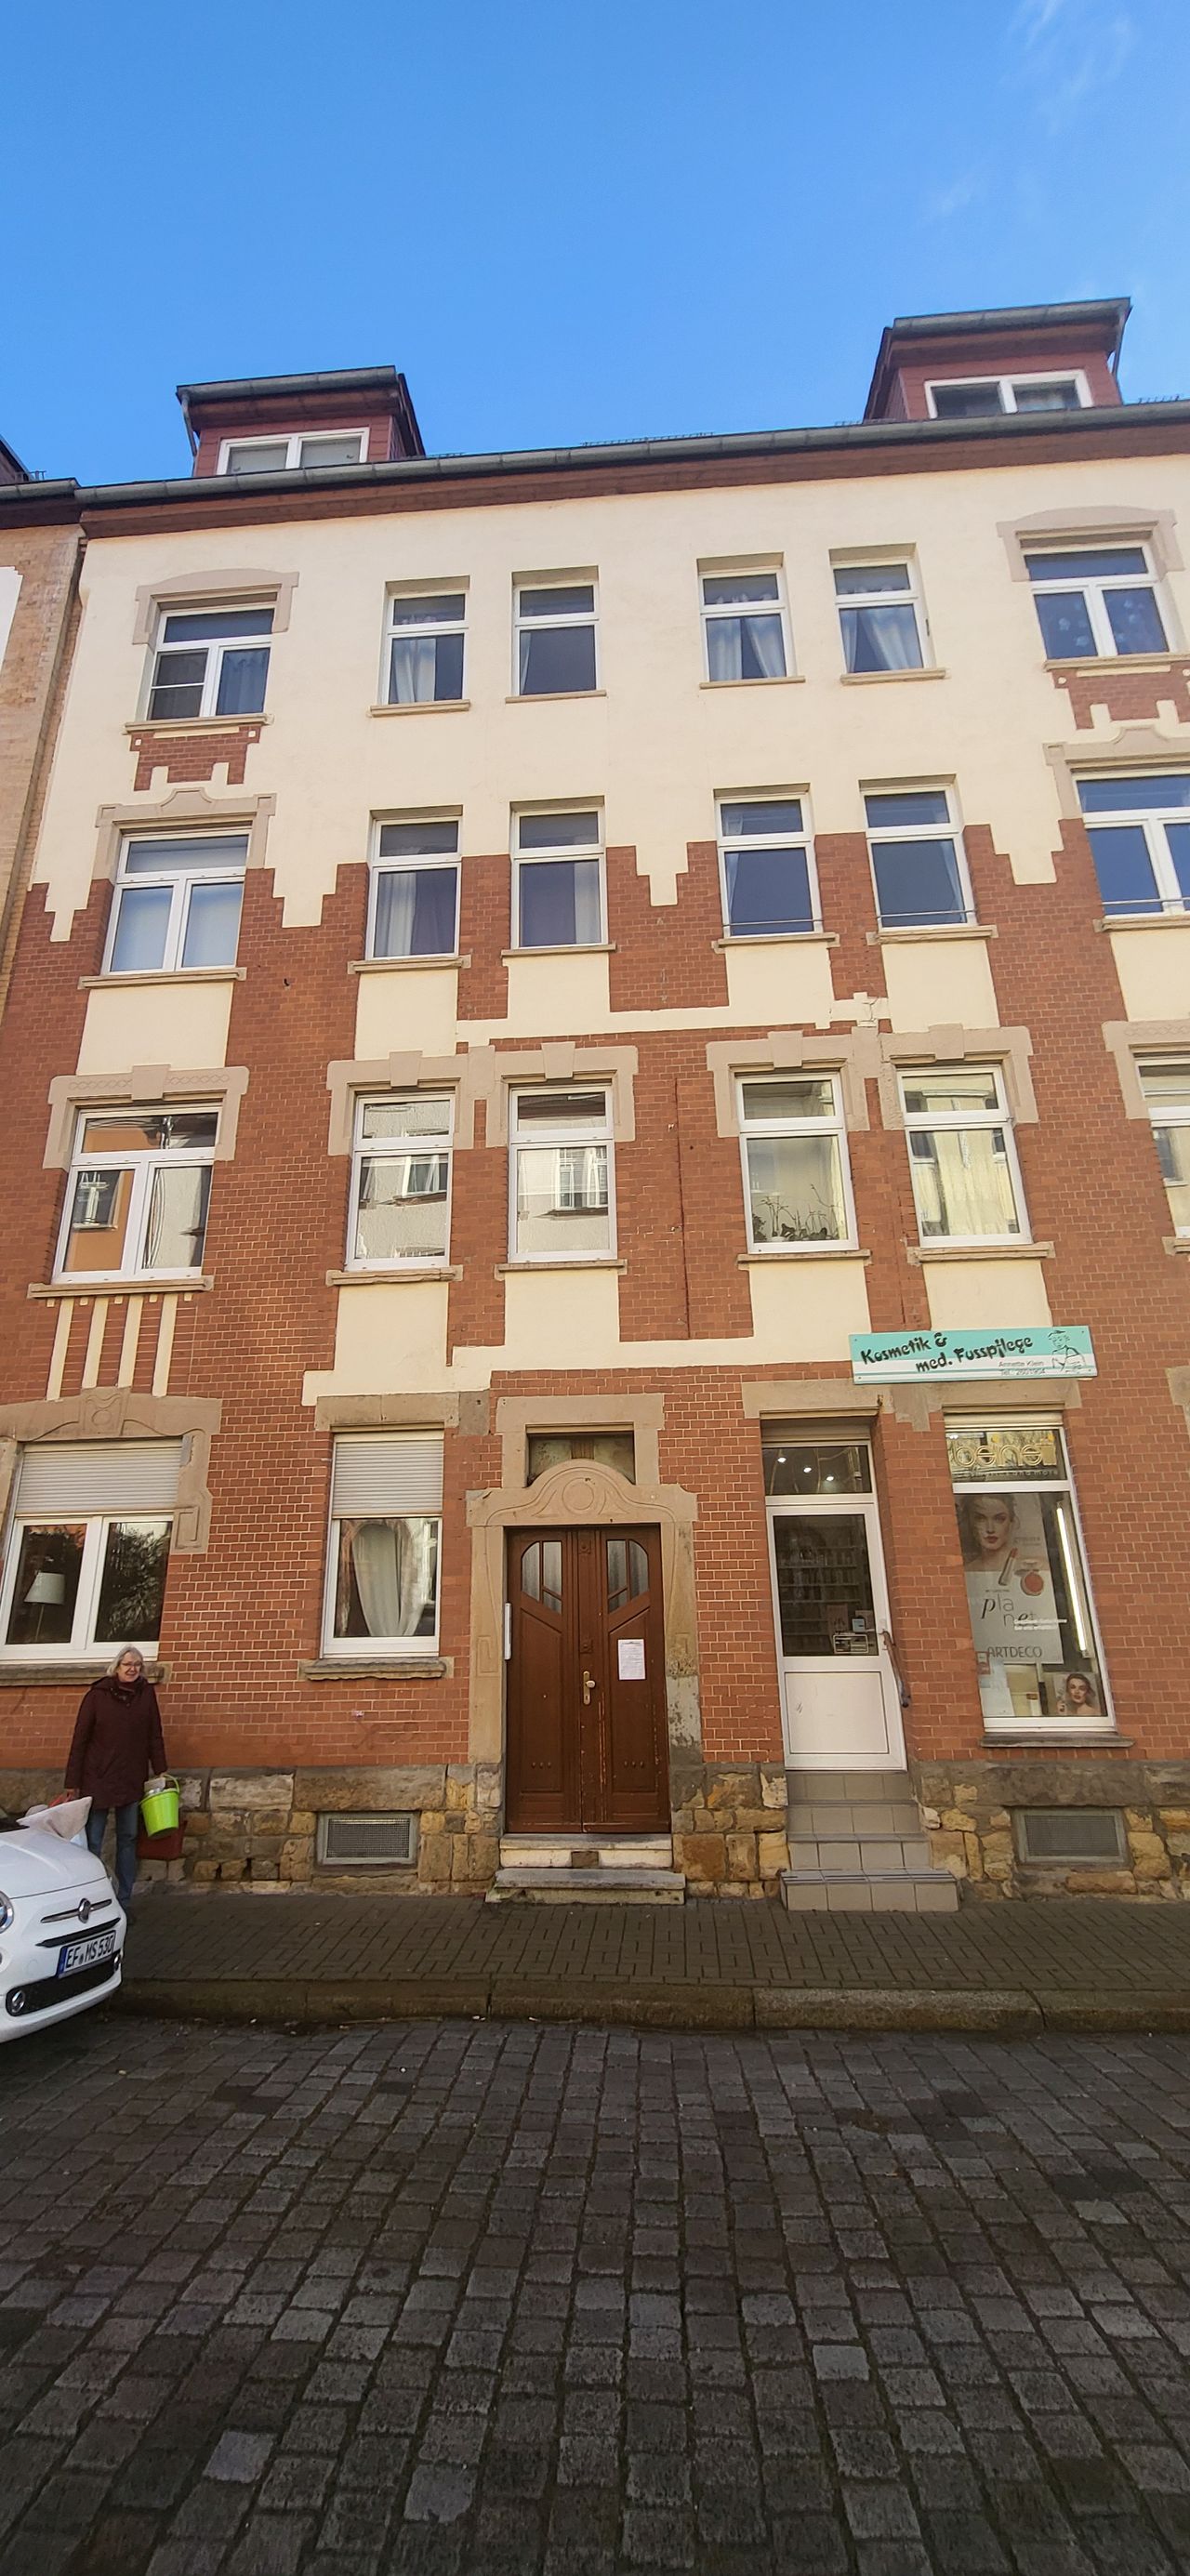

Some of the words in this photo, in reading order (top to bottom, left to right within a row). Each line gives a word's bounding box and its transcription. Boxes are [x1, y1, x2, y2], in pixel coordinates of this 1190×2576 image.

[860, 1337, 932, 1365] Kosmetik
[934, 1332, 947, 1347] &
[916, 1352, 953, 1372] med.
[953, 1336, 1033, 1364] Fusspflege
[987, 1645, 1042, 1658] ARTDECO
[66, 1946, 81, 1969] EF
